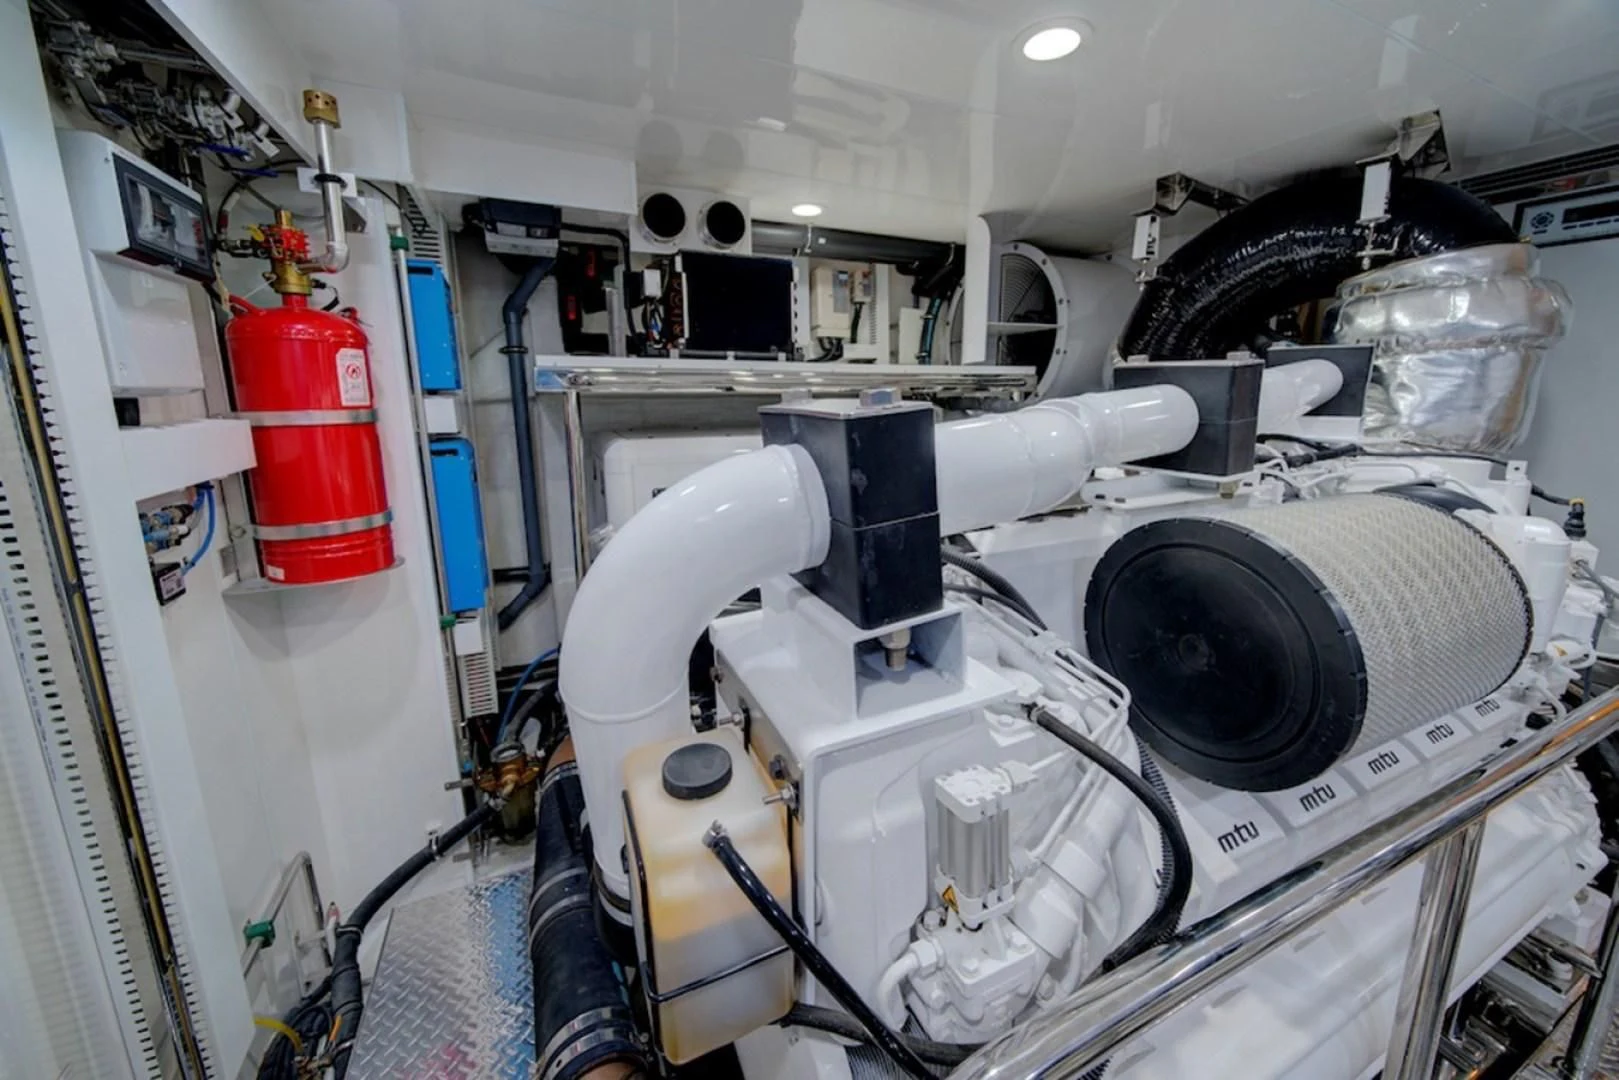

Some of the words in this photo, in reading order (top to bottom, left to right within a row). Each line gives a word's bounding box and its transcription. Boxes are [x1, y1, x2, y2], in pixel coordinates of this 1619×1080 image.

[1475, 699, 1500, 716] mtu
[1426, 722, 1455, 744] mtu
[1368, 750, 1400, 775] mtu
[1299, 782, 1336, 812] mtu
[1217, 820, 1260, 853] mtu
